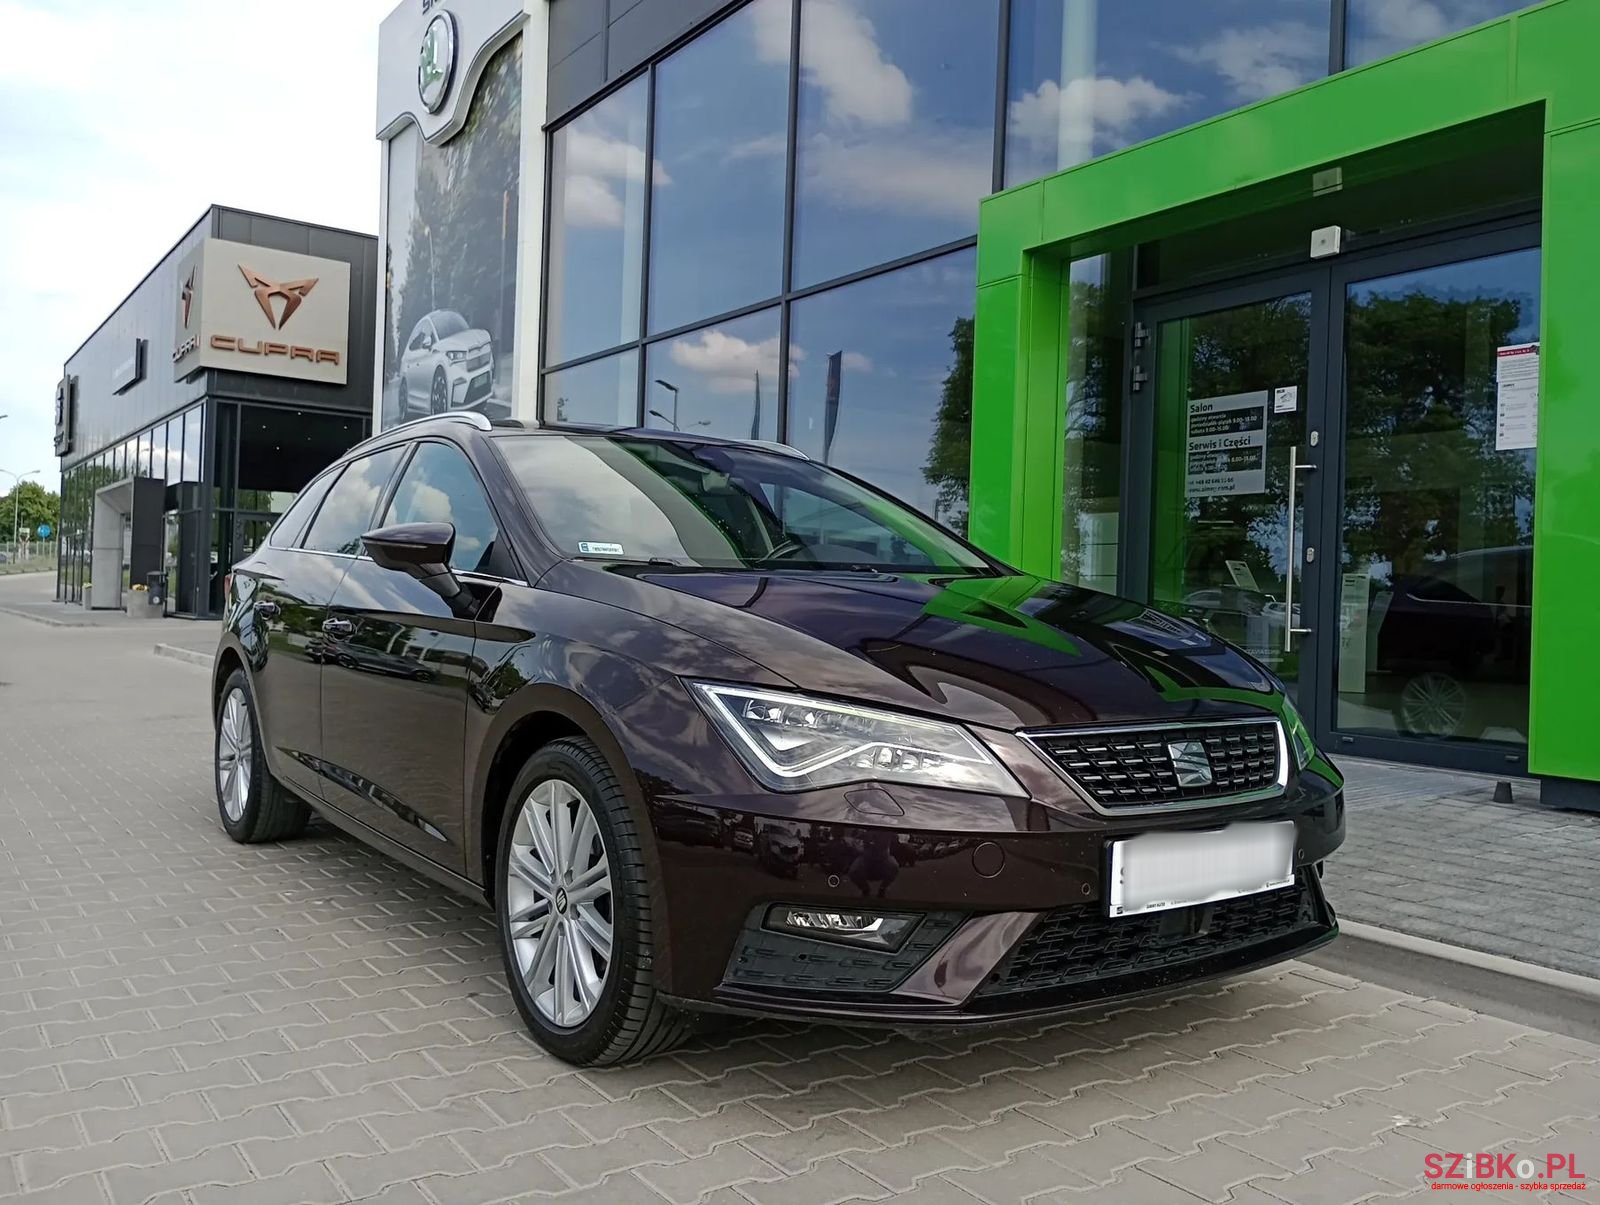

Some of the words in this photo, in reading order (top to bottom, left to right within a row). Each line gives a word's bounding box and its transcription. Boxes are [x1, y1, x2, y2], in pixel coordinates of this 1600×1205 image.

[210, 334, 340, 366] CUPRA
[1190, 403, 1213, 413] Salon
[1189, 440, 1217, 451] Serwis
[1223, 436, 1251, 449] Części
